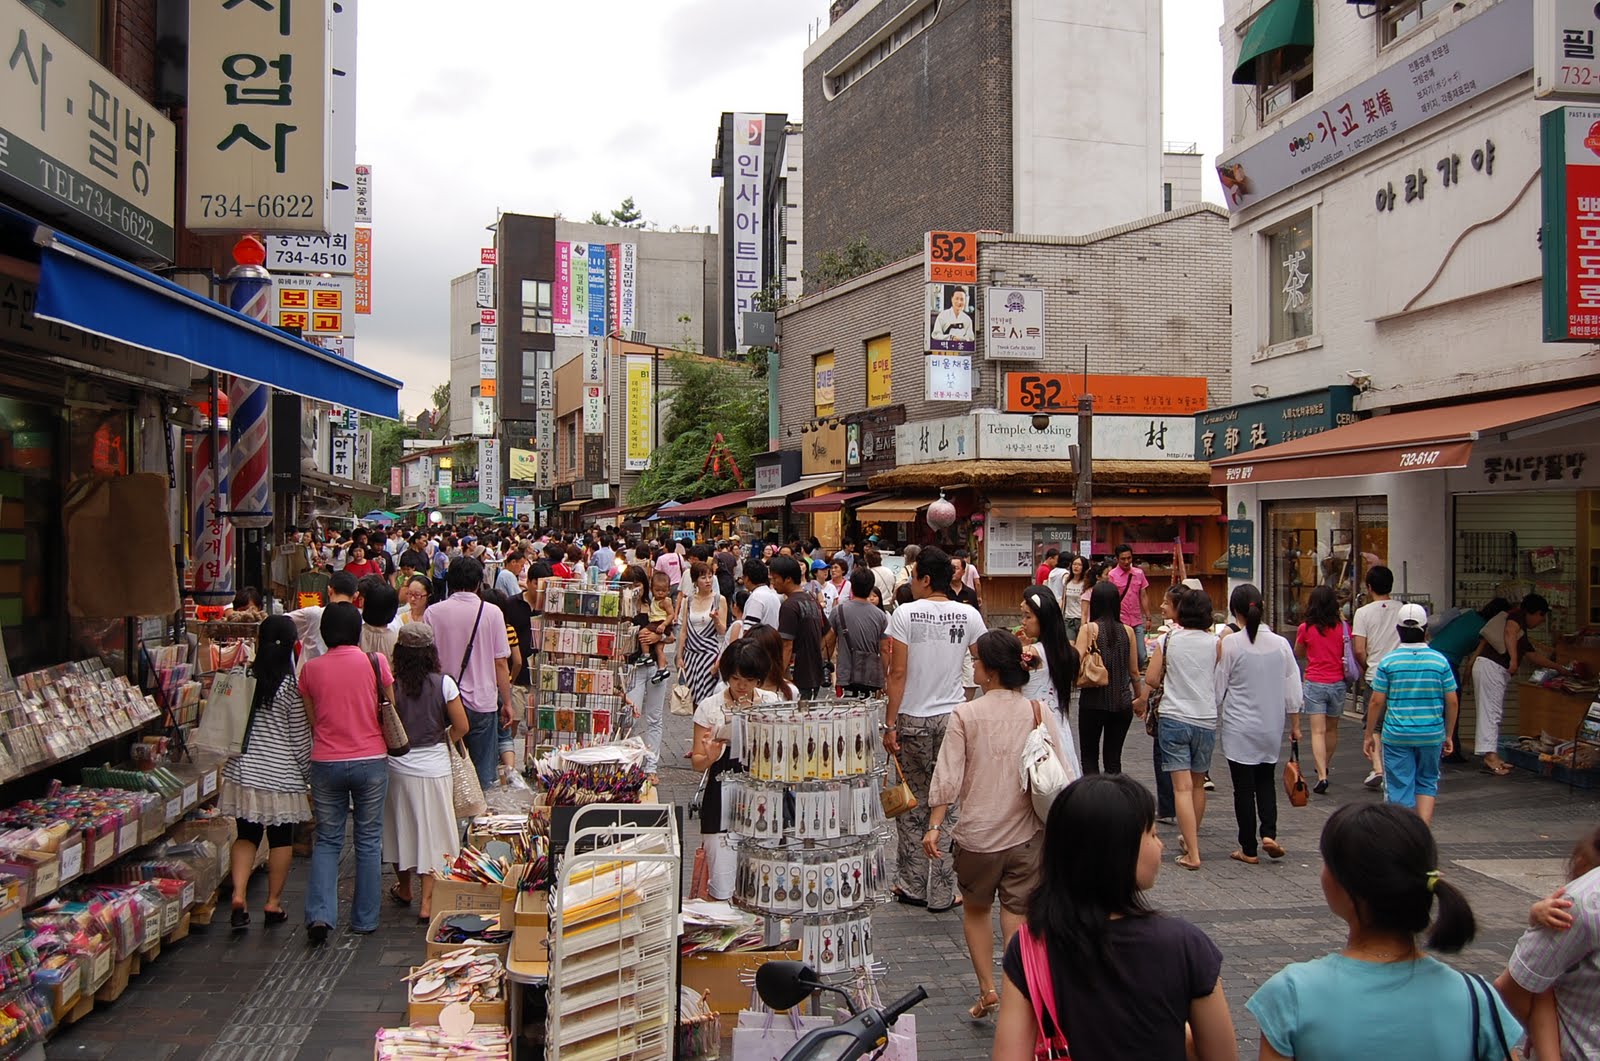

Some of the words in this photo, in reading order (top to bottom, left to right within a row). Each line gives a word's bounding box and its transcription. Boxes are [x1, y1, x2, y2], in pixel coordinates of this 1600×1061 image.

[1561, 66, 1600, 85] 732-
[1317, 103, 1360, 147] 가교
[1362, 88, 1394, 124] 架橋
[1376, 138, 1496, 212] 아라가야
[39, 158, 155, 246] TEL:734-6622
[200, 195, 314, 218] 734-6622
[932, 233, 966, 263] 532
[275, 250, 347, 266] 734-4510
[282, 291, 338, 308] 보물
[282, 314, 338, 331] 창고
[991, 325, 1041, 339] 질시루
[872, 359, 890, 374] 토마토
[1020, 375, 1062, 410] 532
[987, 424, 1026, 437] Temple
[1029, 424, 1072, 437] Cooking
[1144, 421, 1168, 450] 村
[1201, 421, 1268, 458] 京都社
[1399, 451, 1441, 467] 732-6147
[1050, 531, 1072, 540] SEOUL
[910, 612, 935, 620] main
[938, 612, 968, 622] titles
